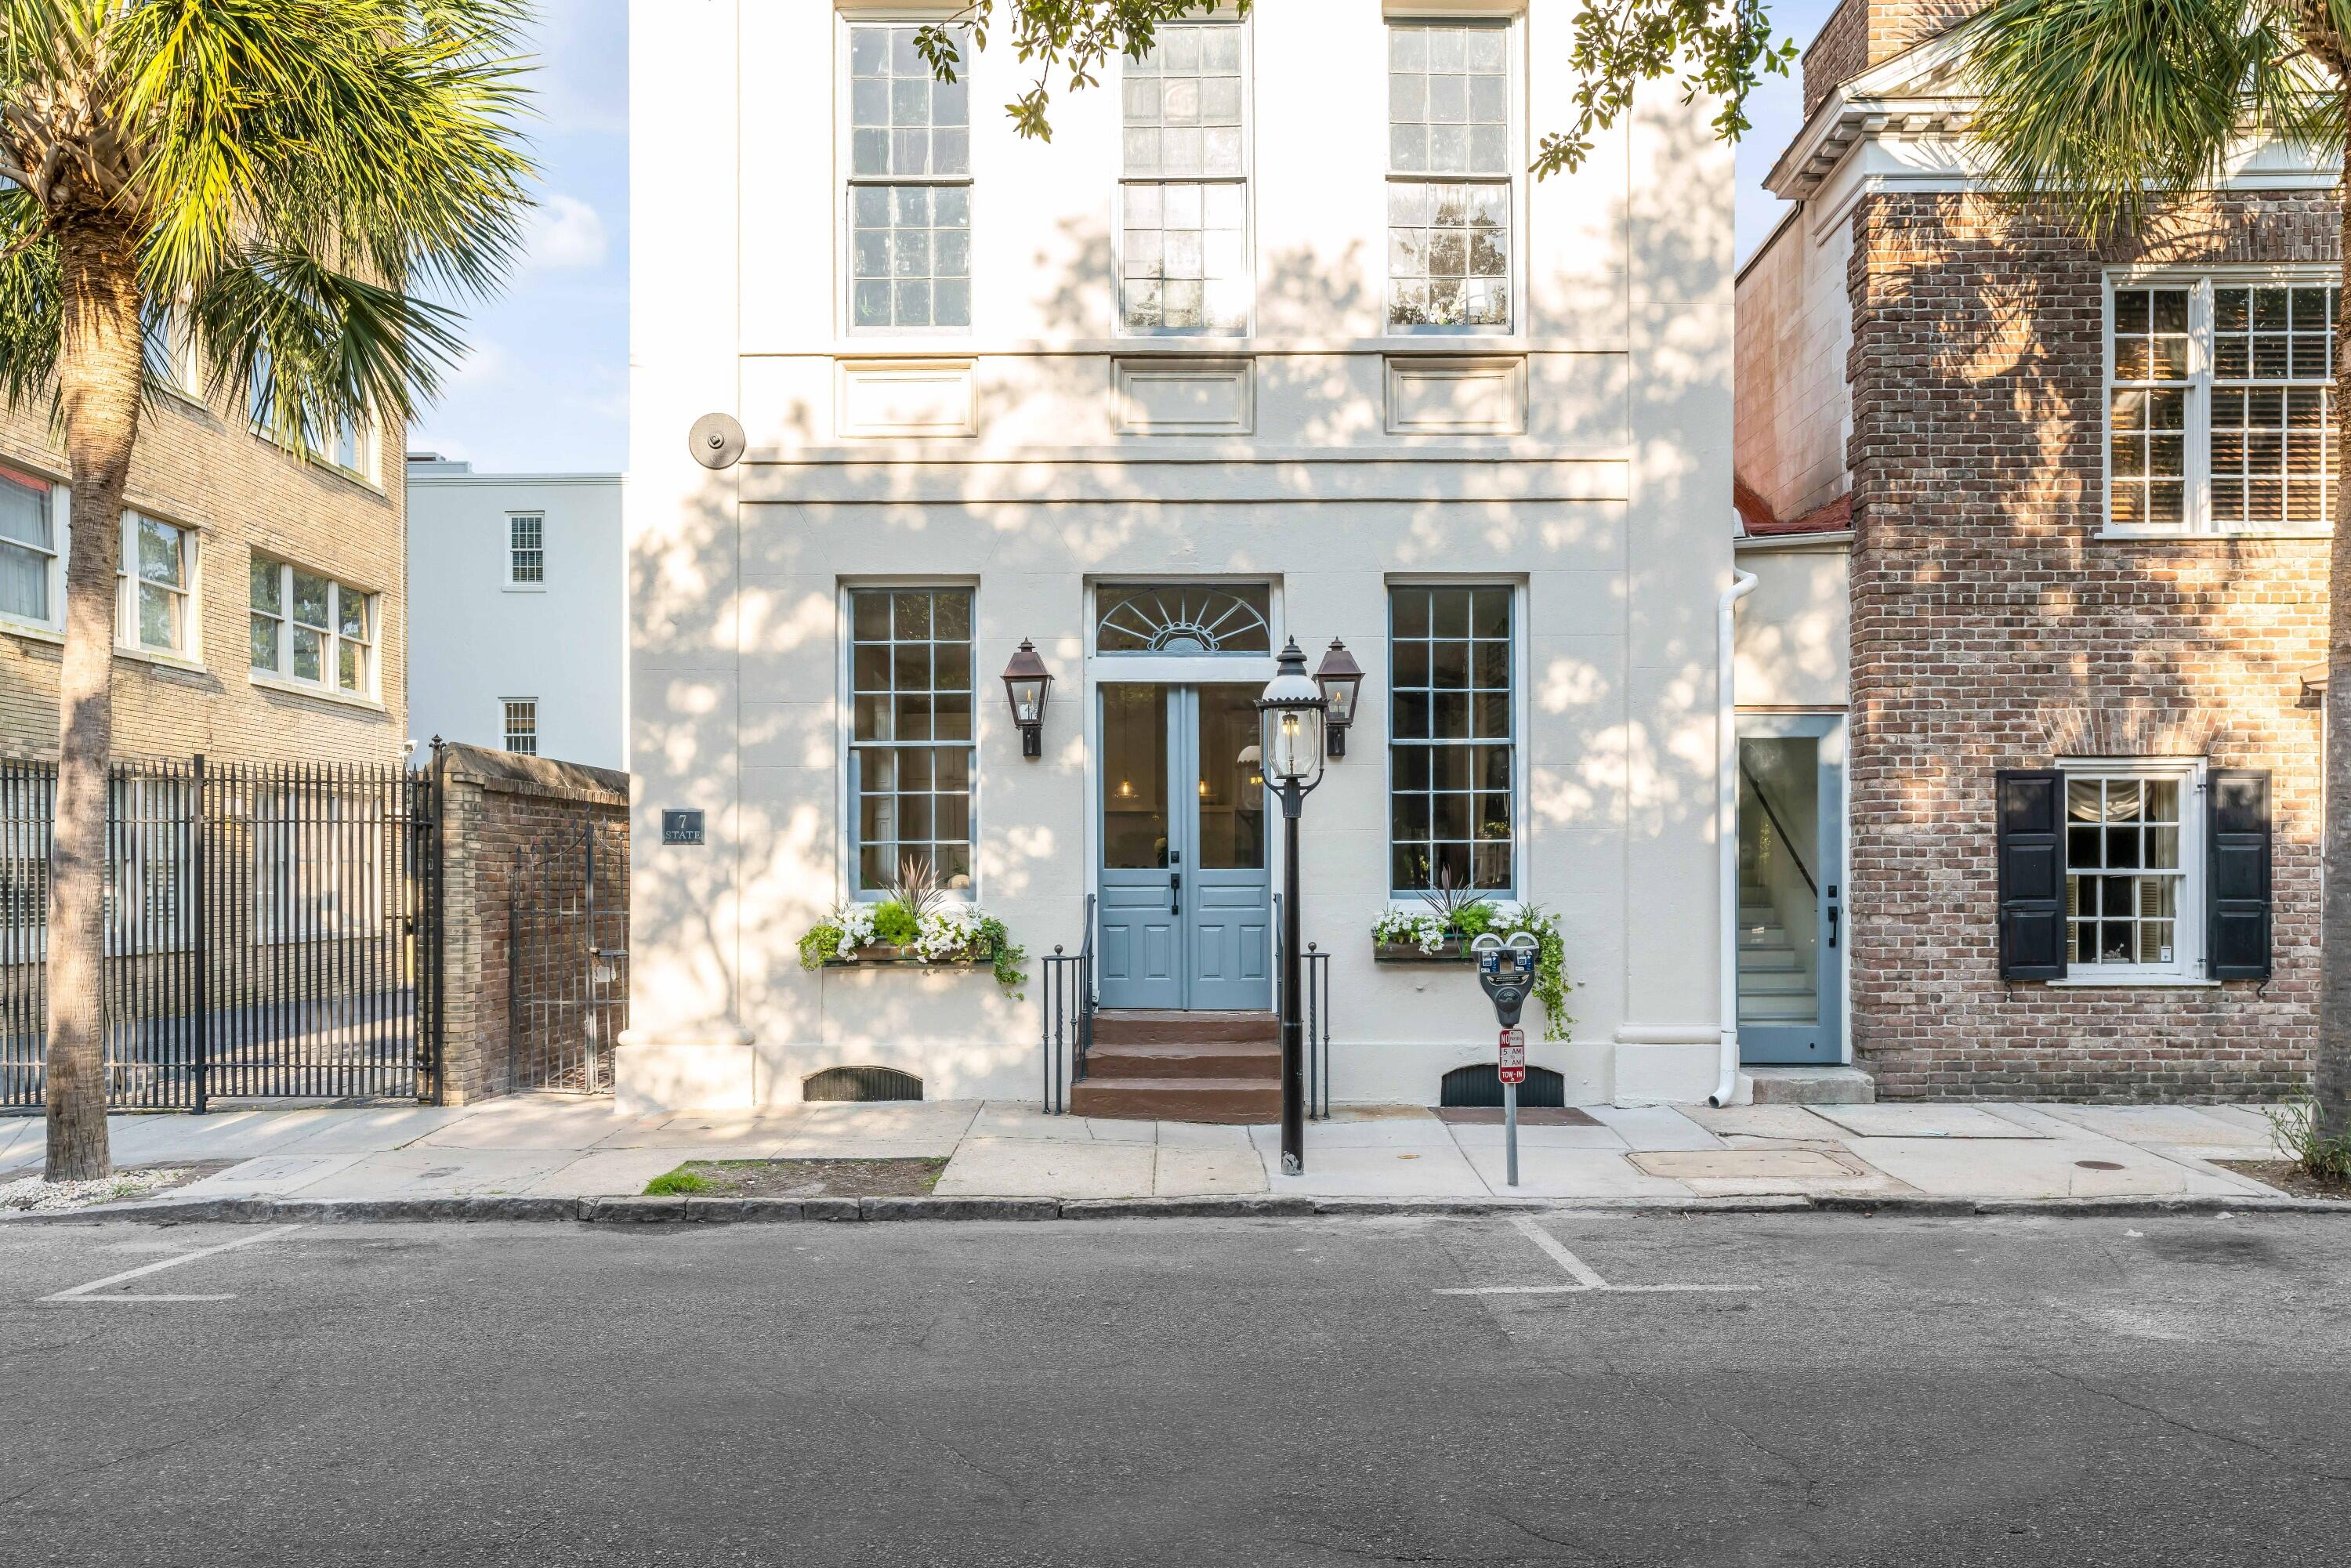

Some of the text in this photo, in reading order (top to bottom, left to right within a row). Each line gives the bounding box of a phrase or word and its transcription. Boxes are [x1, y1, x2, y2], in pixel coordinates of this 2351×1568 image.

[679, 814, 686, 829] 7
[665, 831, 701, 839] STATE
[1501, 1034, 1509, 1045] NO
